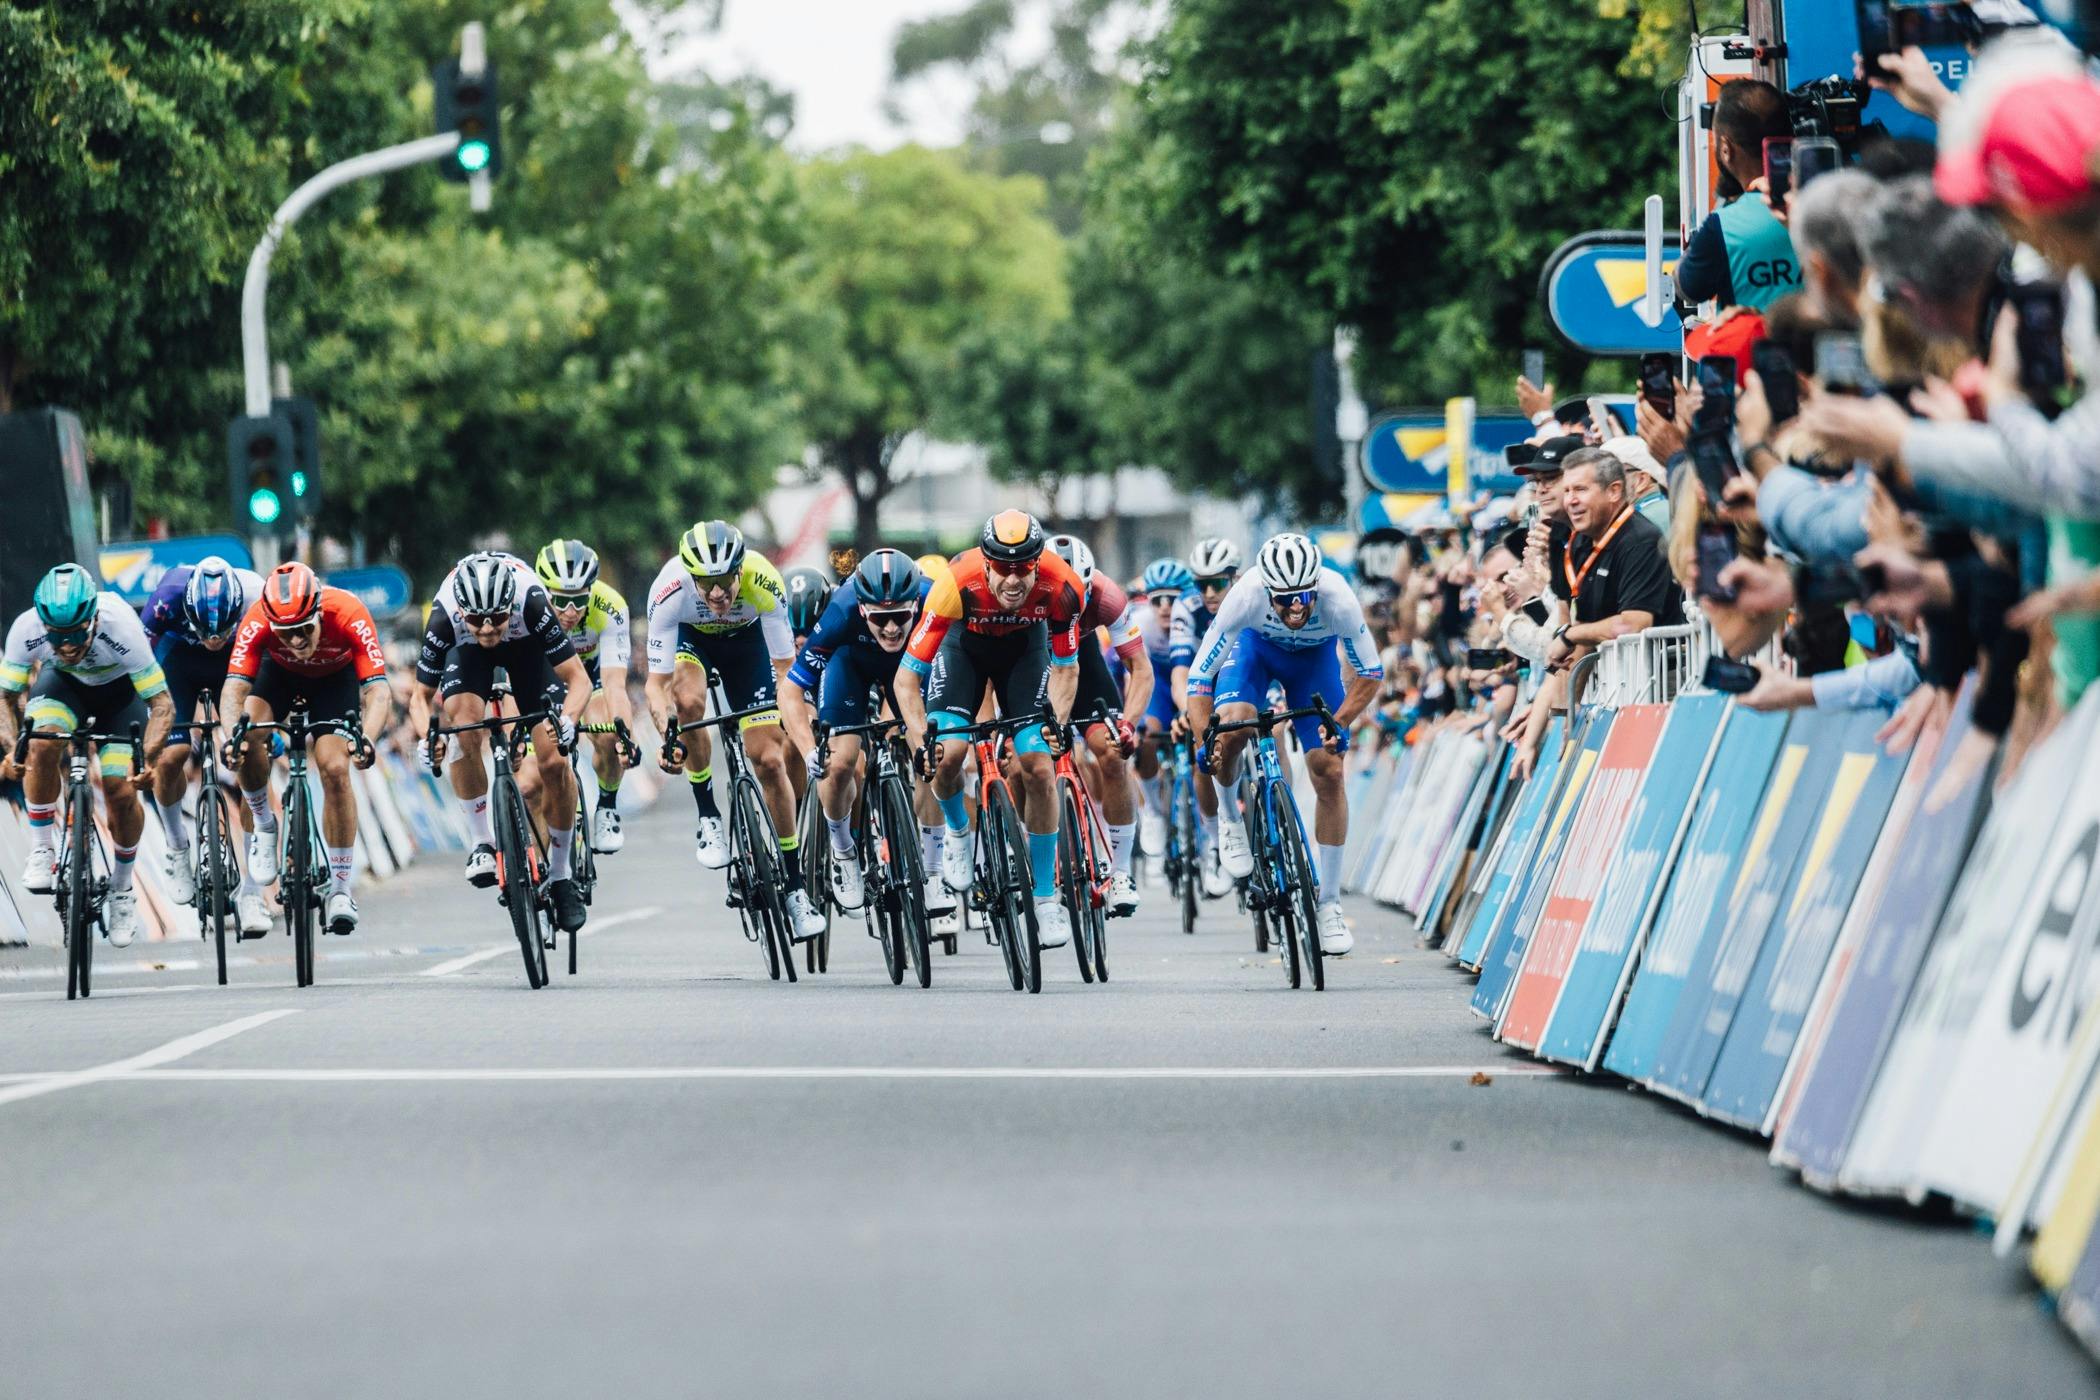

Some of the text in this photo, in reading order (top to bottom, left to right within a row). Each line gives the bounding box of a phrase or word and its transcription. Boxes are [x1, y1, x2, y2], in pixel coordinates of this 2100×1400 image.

[229, 620, 264, 668] ARKEA
[351, 619, 385, 669] ARKEA
[1199, 632, 1228, 674] GIANT
[1343, 637, 1365, 672] GIANT
